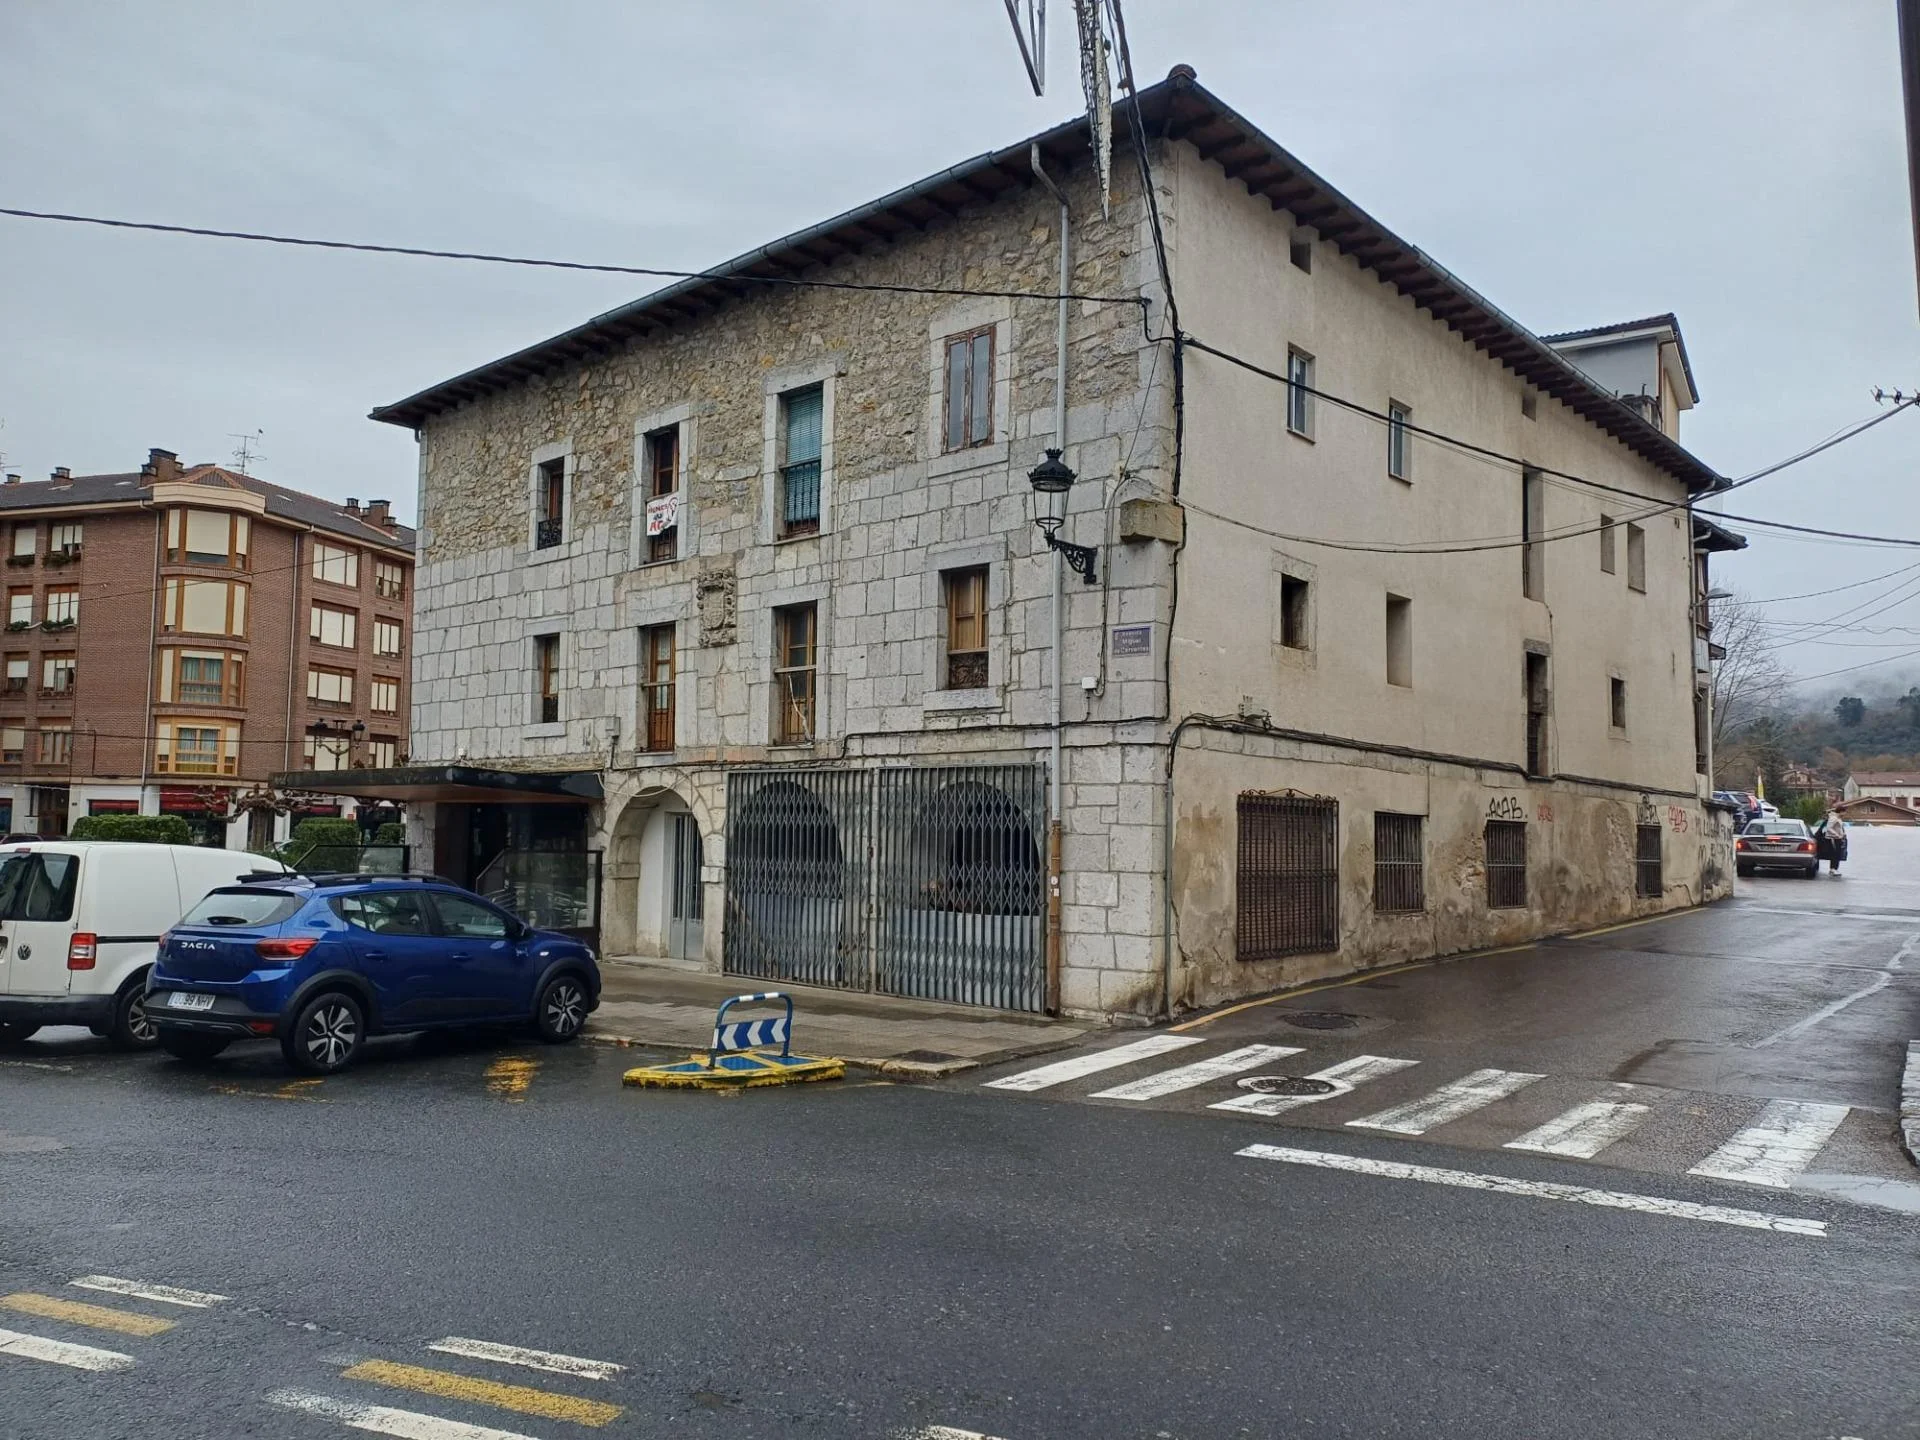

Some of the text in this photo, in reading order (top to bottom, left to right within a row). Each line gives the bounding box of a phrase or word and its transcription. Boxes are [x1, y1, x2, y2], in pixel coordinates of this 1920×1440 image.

[1122, 638, 1142, 646] Miguel
[1121, 646, 1150, 654] Cervantes
[181, 941, 216, 950] DACIA
